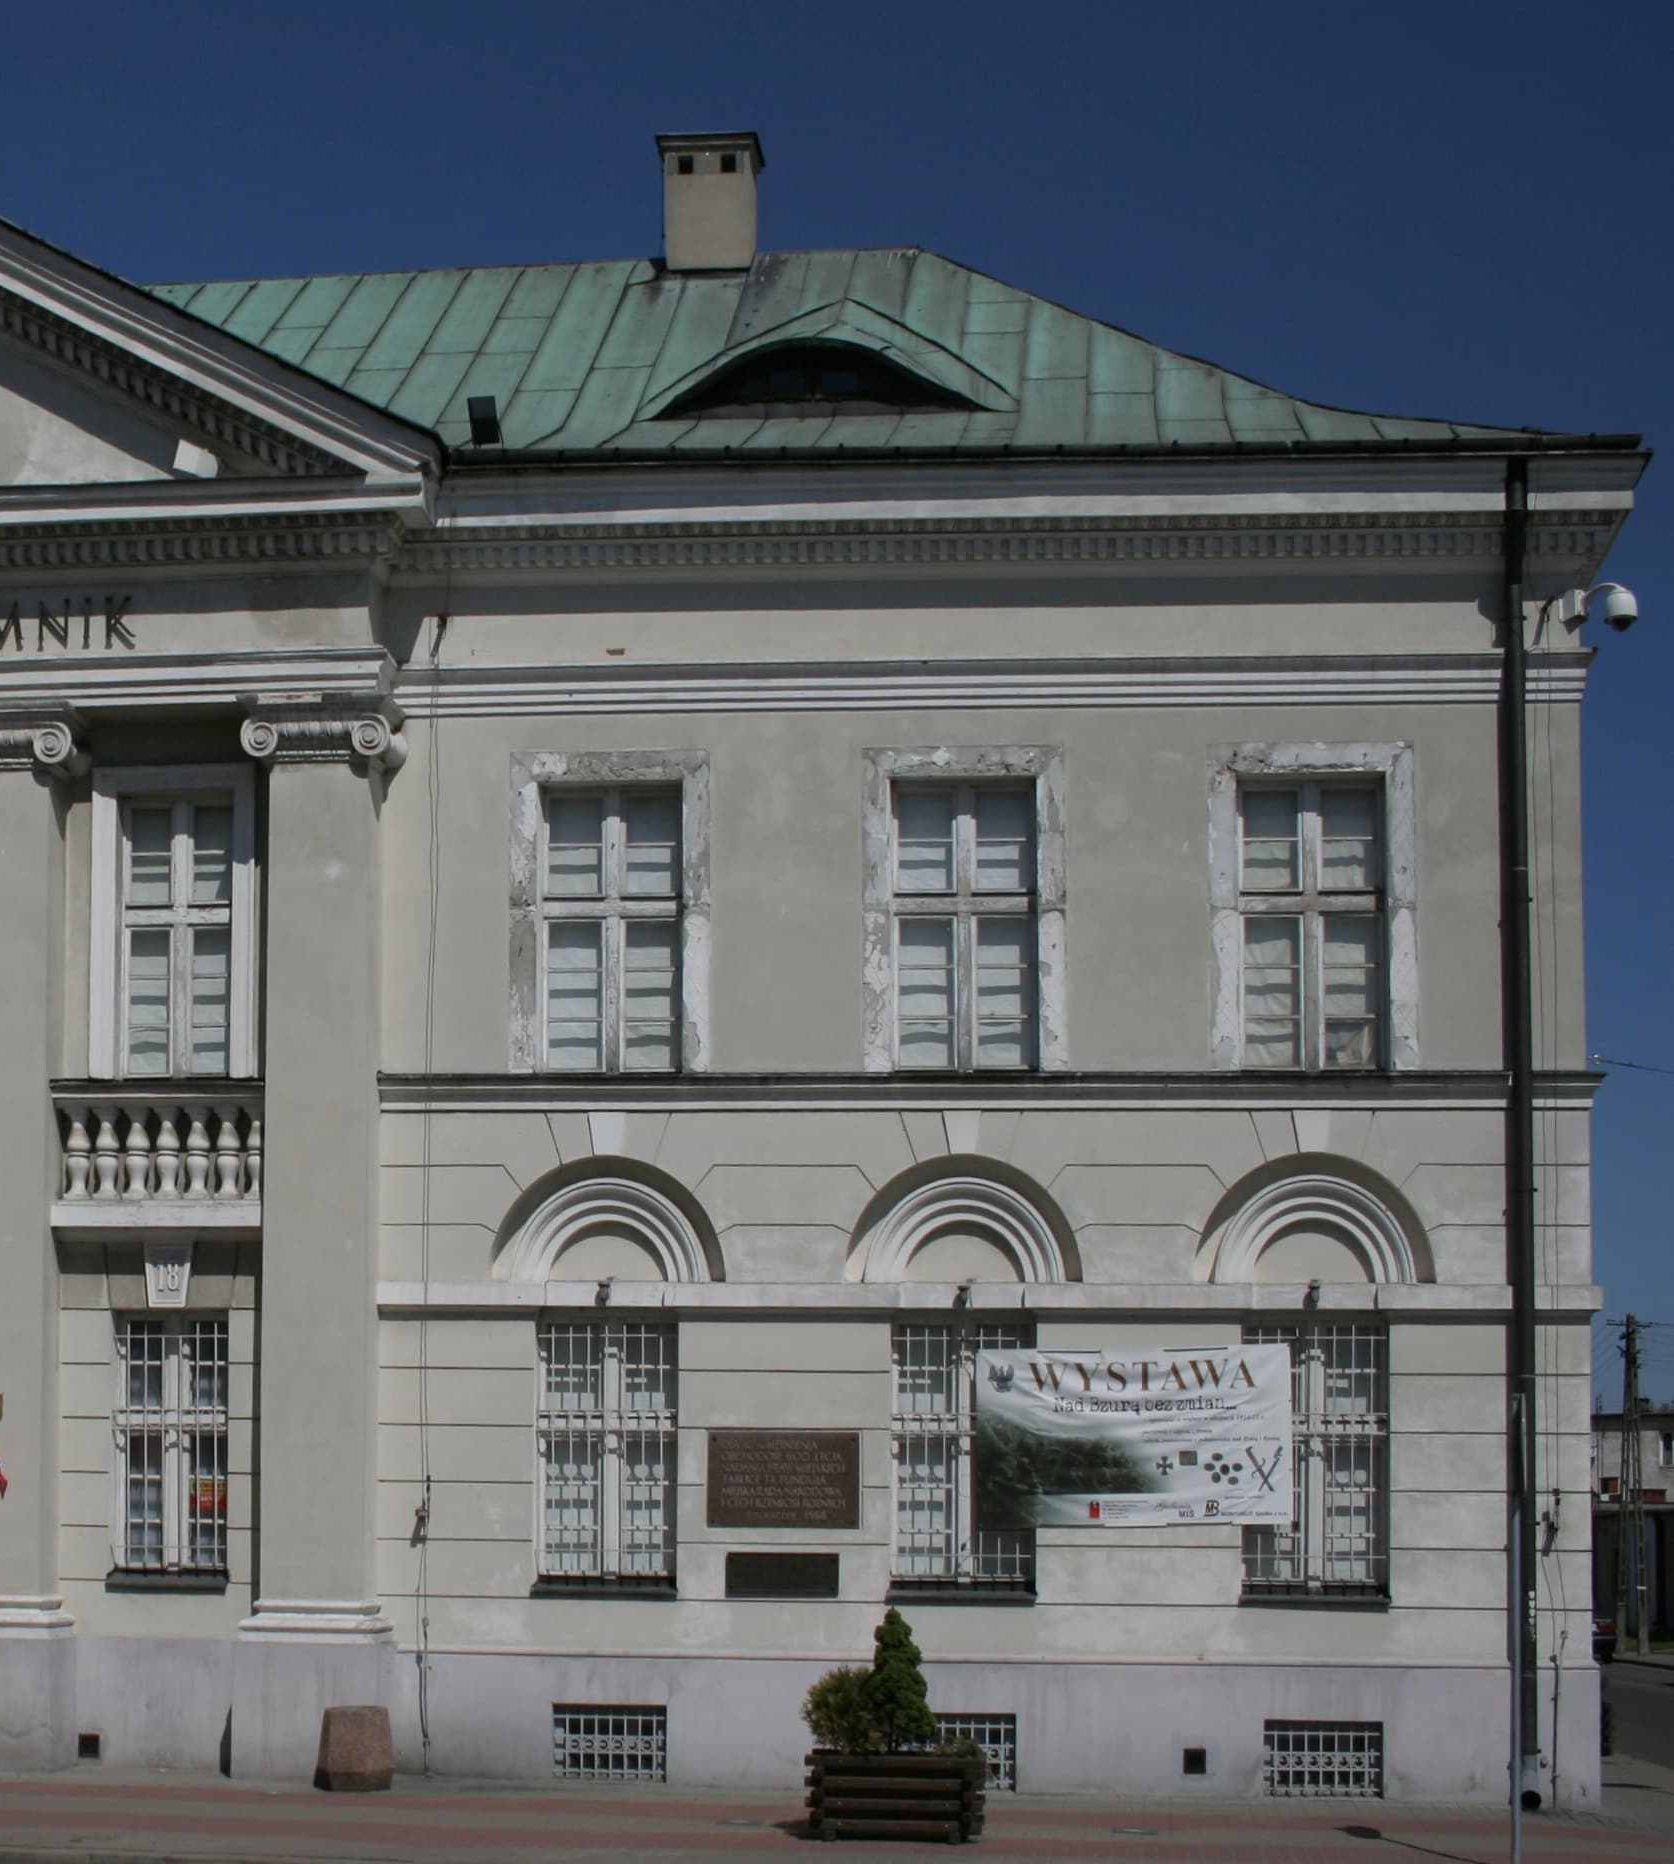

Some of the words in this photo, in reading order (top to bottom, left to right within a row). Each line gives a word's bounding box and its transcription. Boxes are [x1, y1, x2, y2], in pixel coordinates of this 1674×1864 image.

[1028, 1358, 1256, 1393] WYSTAWA
[1053, 1397, 1084, 1413] Nad
[1144, 1396, 1174, 1412] bez
